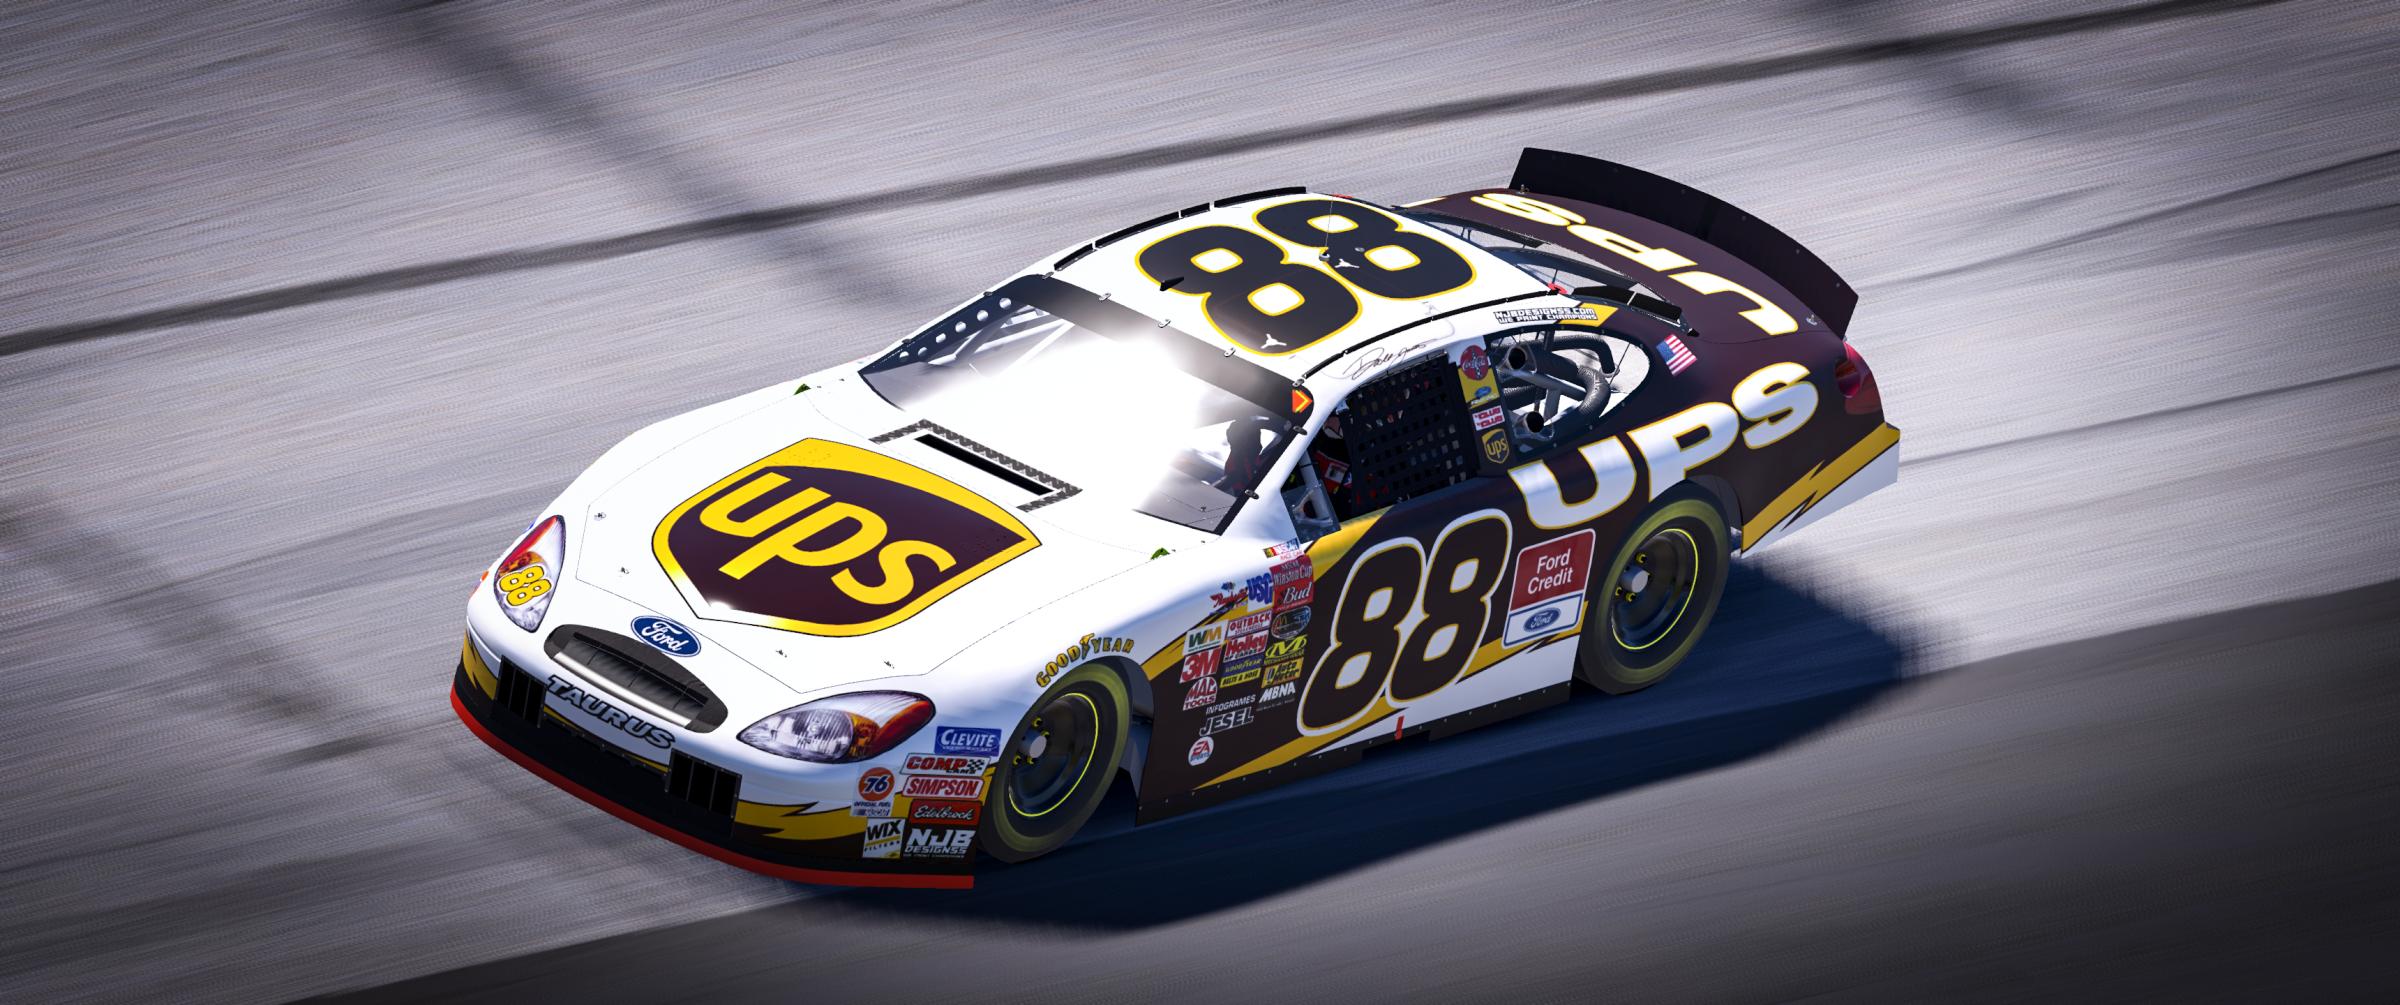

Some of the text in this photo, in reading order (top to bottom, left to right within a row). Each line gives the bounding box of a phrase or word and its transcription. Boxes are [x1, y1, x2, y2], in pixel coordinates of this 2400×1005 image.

[1135, 199, 1475, 358] 88
[1509, 361, 1819, 529] UPS
[1299, 564, 1313, 579] Cup
[1537, 548, 1571, 574] Ford
[499, 564, 551, 607] 88
[1527, 567, 1573, 594] Credit
[1282, 582, 1312, 604] Bud
[1229, 612, 1271, 631] OUTBACK
[1297, 508, 1513, 737] 88
[641, 621, 690, 652] Ford
[1035, 632, 1135, 688] GOODYEAR
[1181, 649, 1222, 682] 3M
[1259, 681, 1296, 703] MBNA
[547, 675, 676, 750] TAURUS
[1206, 694, 1256, 715] INFOGRAMES
[1199, 706, 1254, 737] JESEL
[940, 729, 996, 747] CLEVITE
[906, 756, 969, 771] COMP
[863, 775, 890, 793] 76
[906, 777, 978, 797] SIMPSON
[914, 804, 975, 821] Edelbrock
[867, 819, 901, 841] WIX
[907, 828, 977, 847] NJB
[904, 845, 967, 855] DESIGNSS
